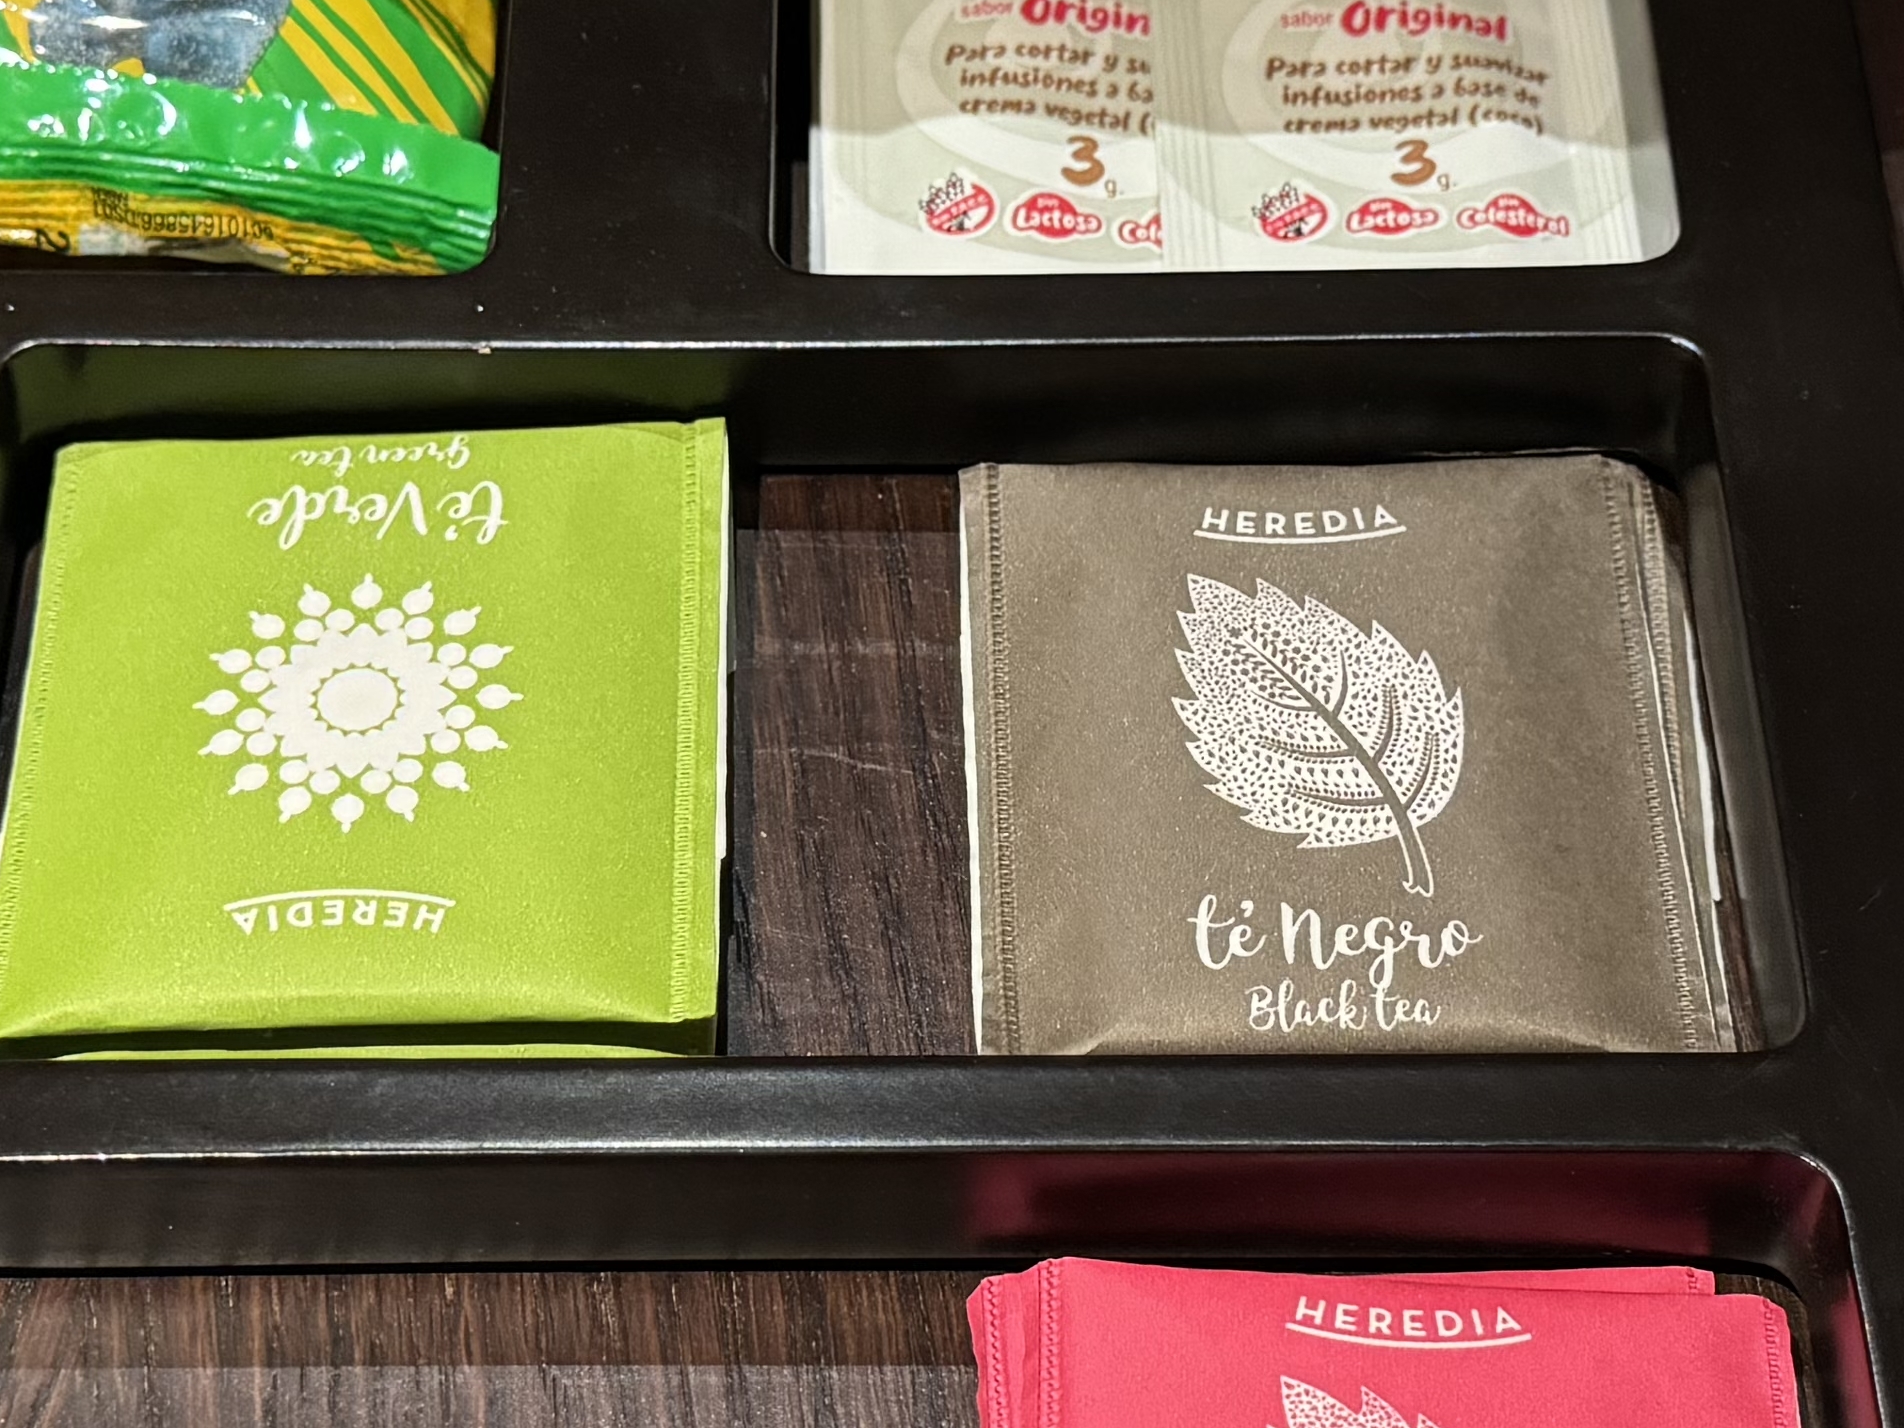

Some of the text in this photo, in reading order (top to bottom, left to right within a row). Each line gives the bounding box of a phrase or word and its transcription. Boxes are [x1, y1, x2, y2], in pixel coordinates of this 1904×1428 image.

[962, 0, 1014, 18] sabor
[1280, 0, 1507, 41] sabor Original
[945, 44, 1007, 66] Para
[1015, 43, 1096, 65] cortar
[1102, 54, 1119, 74] y
[1265, 58, 1327, 80] Para
[1335, 55, 1419, 74] cortar
[1425, 55, 1442, 73] y
[960, 67, 1099, 98] infusiones
[1105, 82, 1120, 100] a
[1282, 77, 1540, 108] infusiones a base de
[959, 98, 1131, 132] crema vegetal
[1283, 118, 1362, 134] crema
[1369, 107, 1459, 134] vegetal
[1061, 135, 1105, 187] 3
[1390, 139, 1437, 186] 3
[1015, 208, 1100, 233] Lactosa
[1349, 209, 1436, 231] Lactosa
[1459, 207, 1567, 236] Colesterol
[290, 445, 354, 478] tea
[247, 480, 509, 551] té Verde
[1201, 504, 1399, 535] HEREDIA
[233, 898, 448, 935] HEREDIA
[1188, 892, 1483, 987] té Negro
[1247, 984, 1442, 1034] Black tea
[1294, 1294, 1523, 1338] HEREDIA
